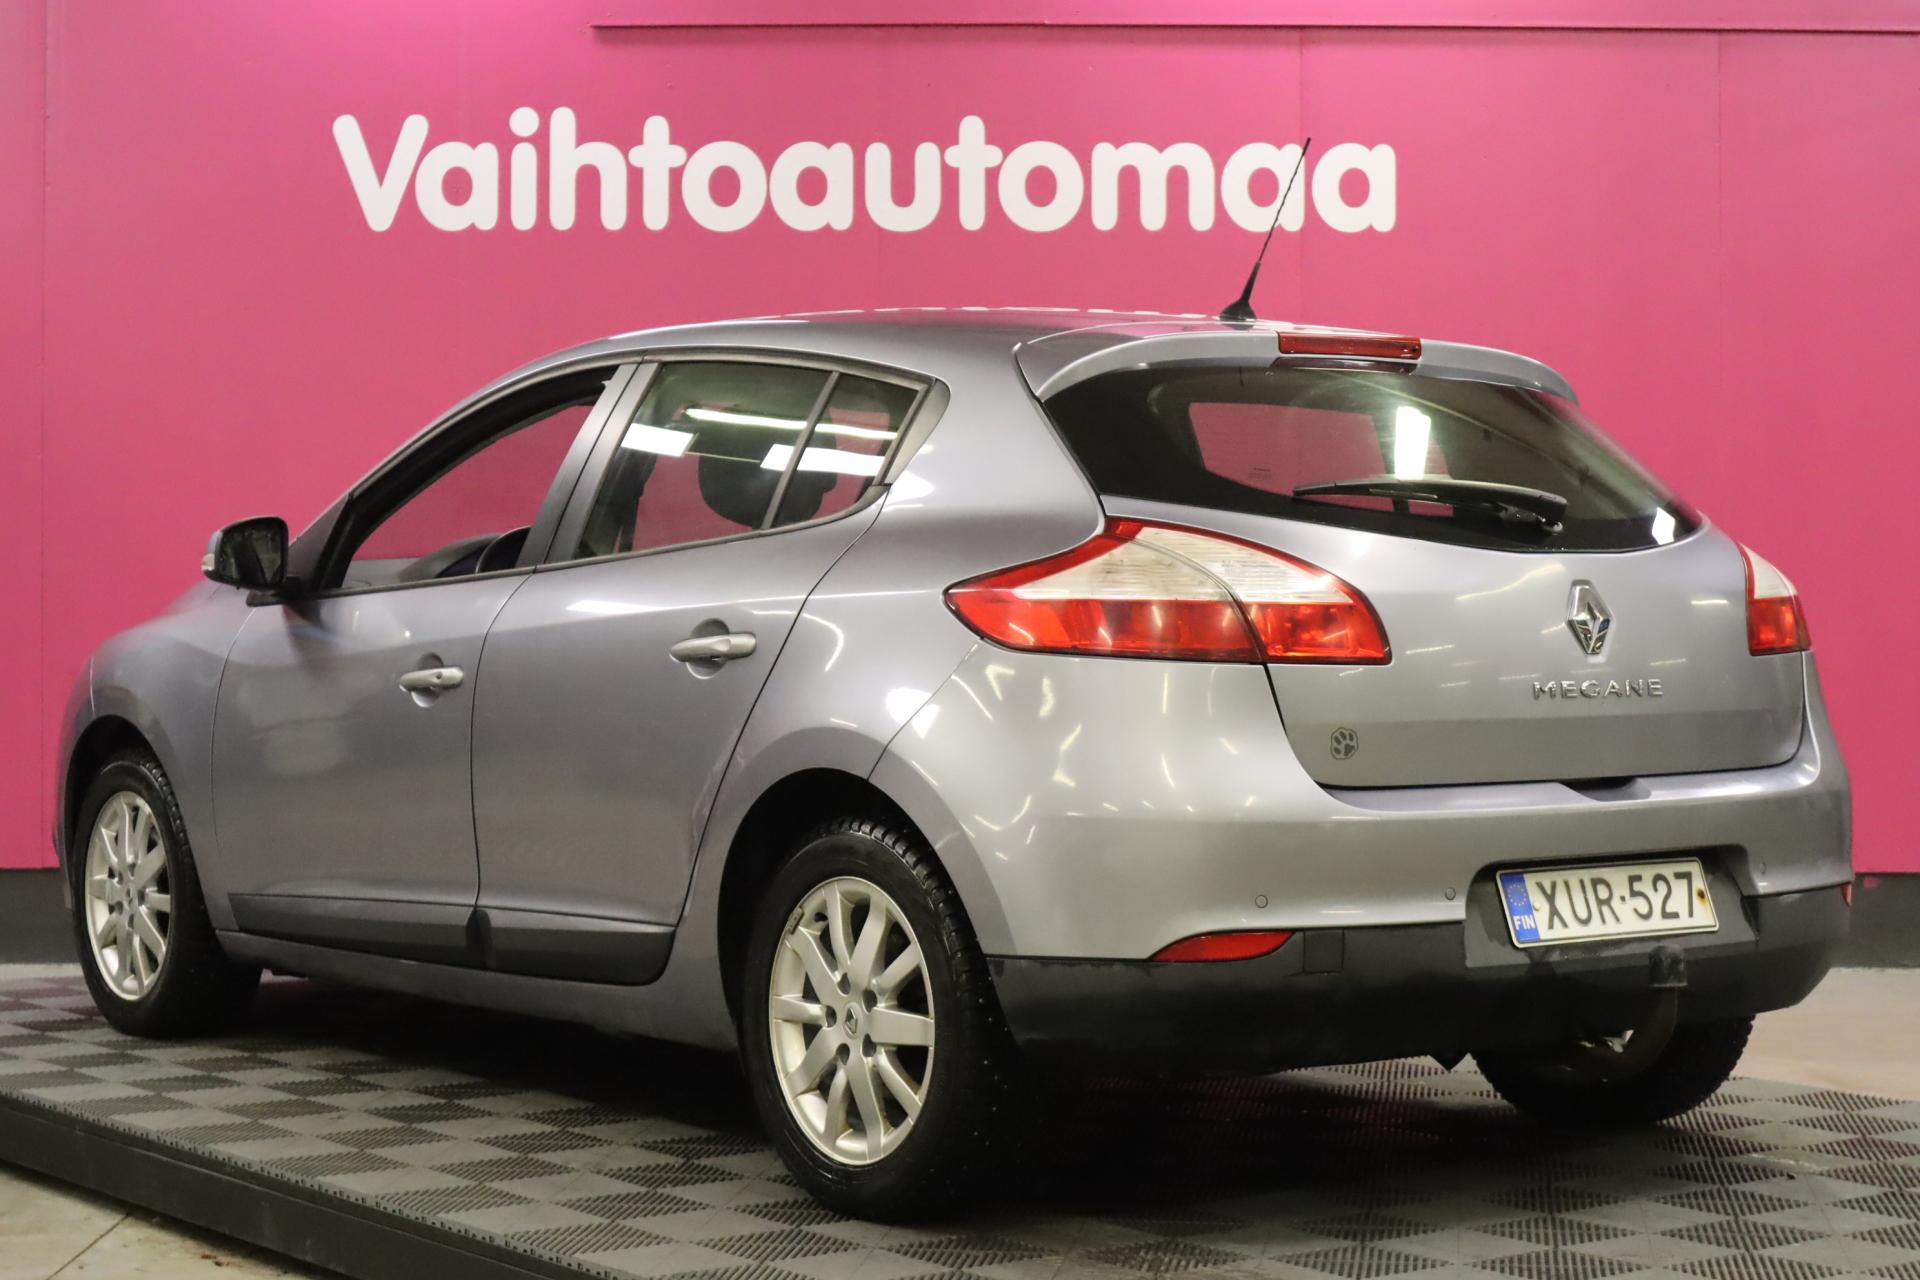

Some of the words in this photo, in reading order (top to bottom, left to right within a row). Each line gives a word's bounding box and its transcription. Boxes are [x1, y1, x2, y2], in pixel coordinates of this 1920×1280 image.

[333, 107, 1396, 232] Vaihtoautomaa
[1533, 678, 1664, 700] MEGANE
[1513, 914, 1536, 930] FIN
